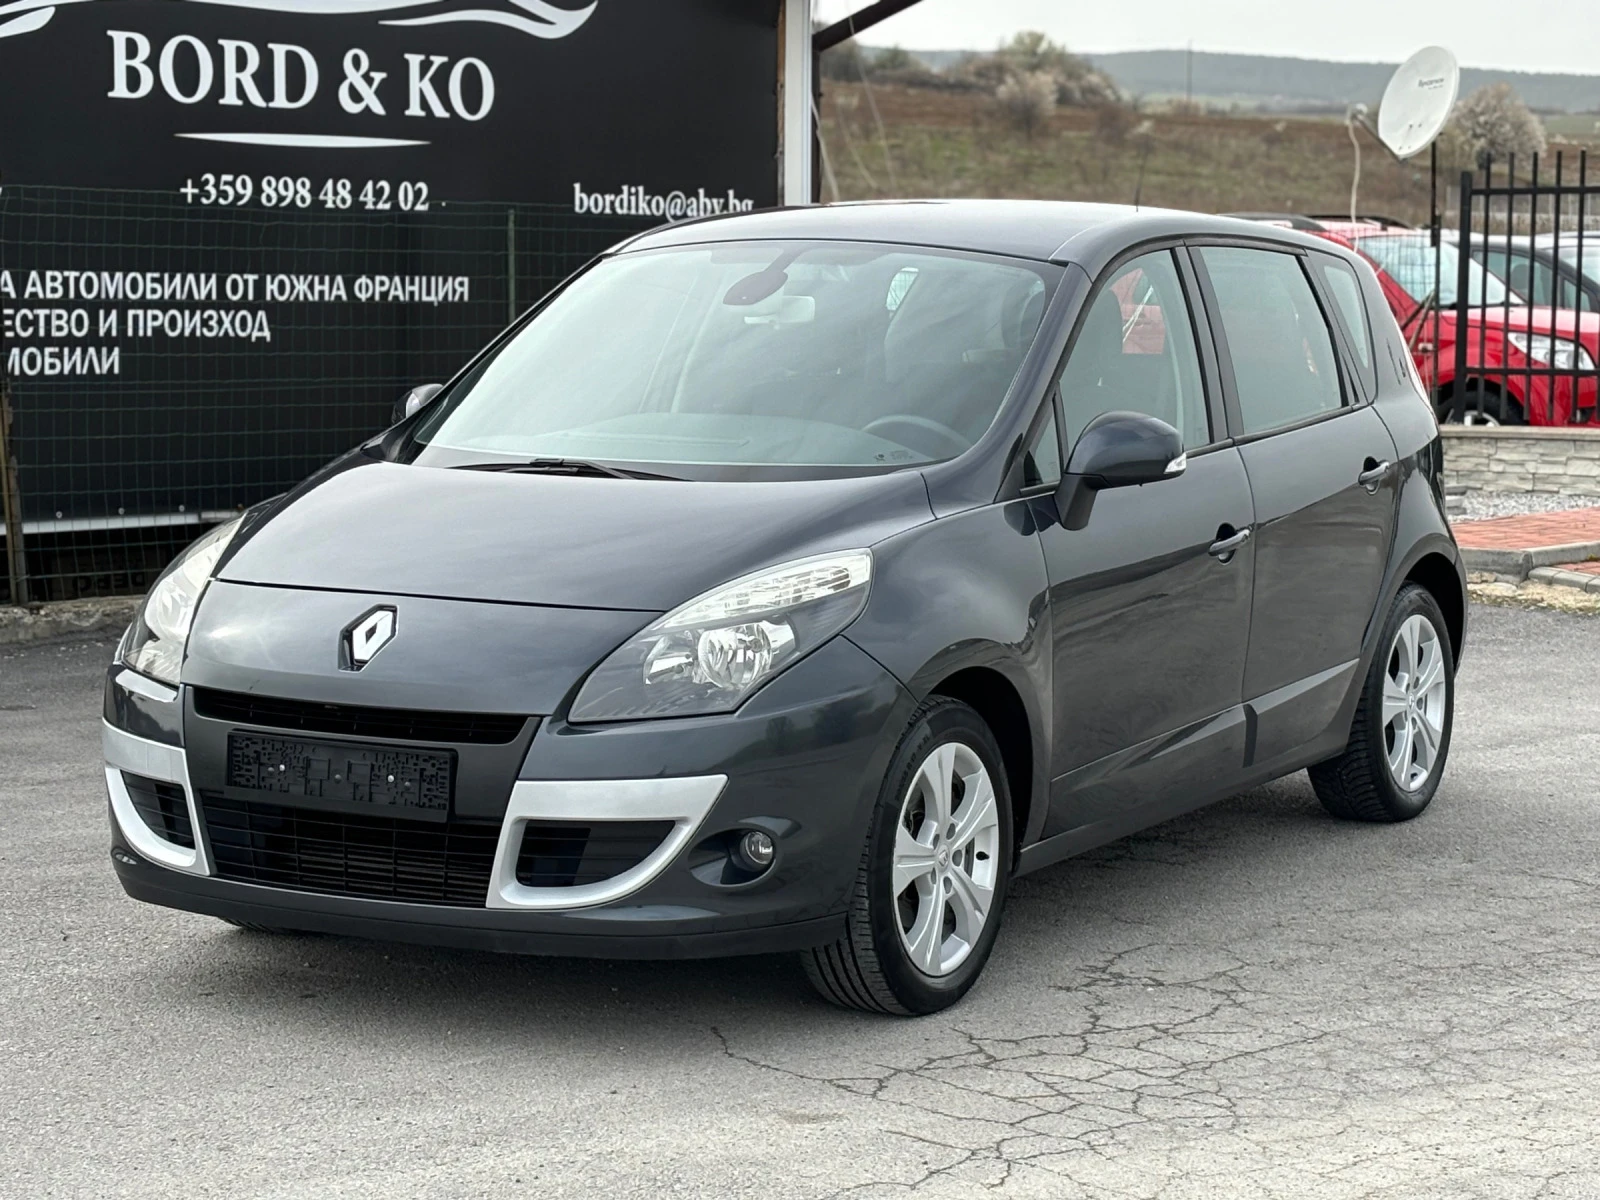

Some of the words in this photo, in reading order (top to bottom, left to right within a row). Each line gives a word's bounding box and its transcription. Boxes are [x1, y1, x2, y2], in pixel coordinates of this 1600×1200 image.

[106, 29, 319, 109] BORD
[337, 47, 388, 116] &
[403, 52, 495, 122] KO
[179, 172, 253, 206] +359
[260, 175, 312, 208] 898
[318, 178, 353, 210] 48
[358, 179, 392, 210] 42
[397, 181, 430, 211] 02
[23, 270, 217, 300] АВТОМОБИЛИ
[225, 273, 259, 301] ОТ
[265, 273, 348, 301] ЮЖНА
[353, 274, 469, 307] ФРАНЦИЯ
[98, 308, 118, 337] И
[127, 308, 271, 342] ПРОИЗХОД
